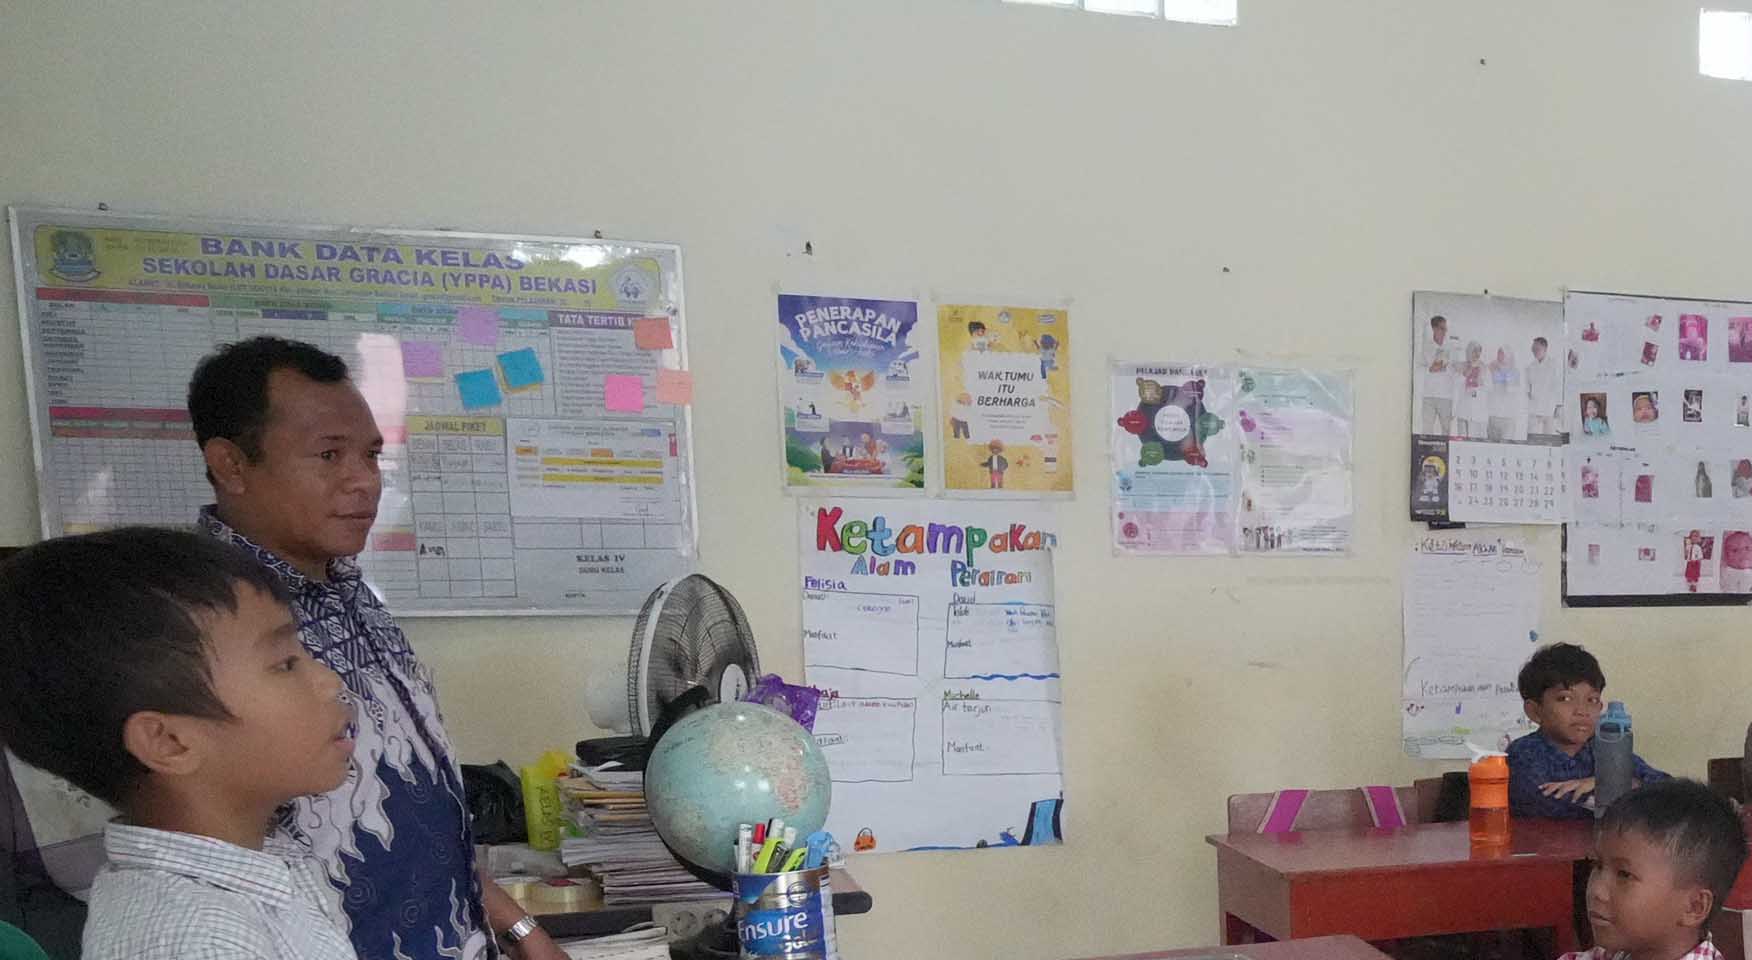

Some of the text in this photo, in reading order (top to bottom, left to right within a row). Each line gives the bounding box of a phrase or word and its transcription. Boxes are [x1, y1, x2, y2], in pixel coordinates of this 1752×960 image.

[200, 237, 526, 270] BANK DATA KELAS
[143, 257, 256, 279] SEKOLAH
[265, 263, 342, 283] DASAR
[350, 267, 435, 287] GRACIA
[441, 271, 513, 294] (YPPA)
[519, 276, 597, 295] BEKASI
[559, 313, 585, 325] TATA
[794, 306, 901, 334] PENERAPAN
[799, 320, 897, 346] PANCASILA
[977, 371, 1035, 382] WAKTUMU
[997, 384, 1016, 394] ITU
[977, 395, 1036, 408] BERHARGA
[1470, 470, 1479, 480] 10
[816, 506, 1058, 567] Ketampakan
[850, 555, 916, 576] Alam
[950, 559, 1032, 587] Perairan
[737, 912, 809, 941] Ensure
